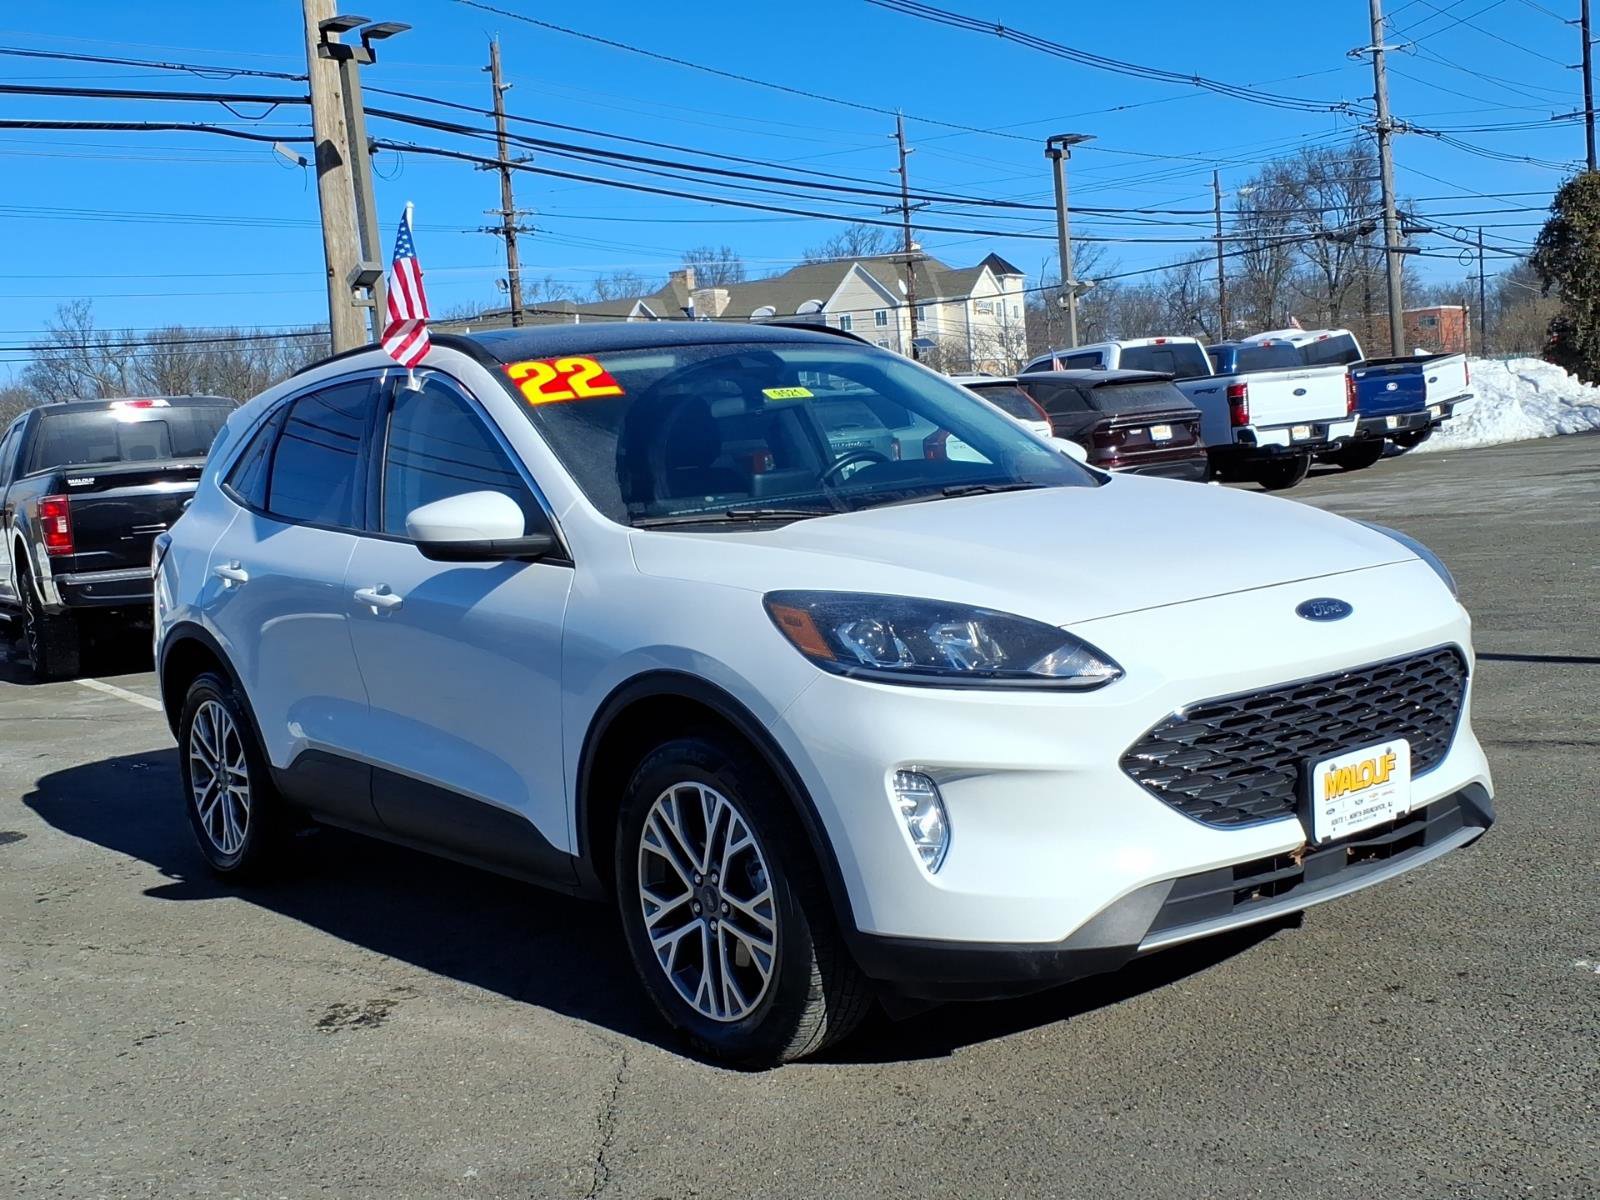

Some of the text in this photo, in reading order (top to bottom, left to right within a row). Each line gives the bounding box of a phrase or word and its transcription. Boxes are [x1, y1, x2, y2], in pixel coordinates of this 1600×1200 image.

[508, 357, 624, 405] 22
[1310, 601, 1342, 616] Ford
[1324, 753, 1397, 801] MALOUF
